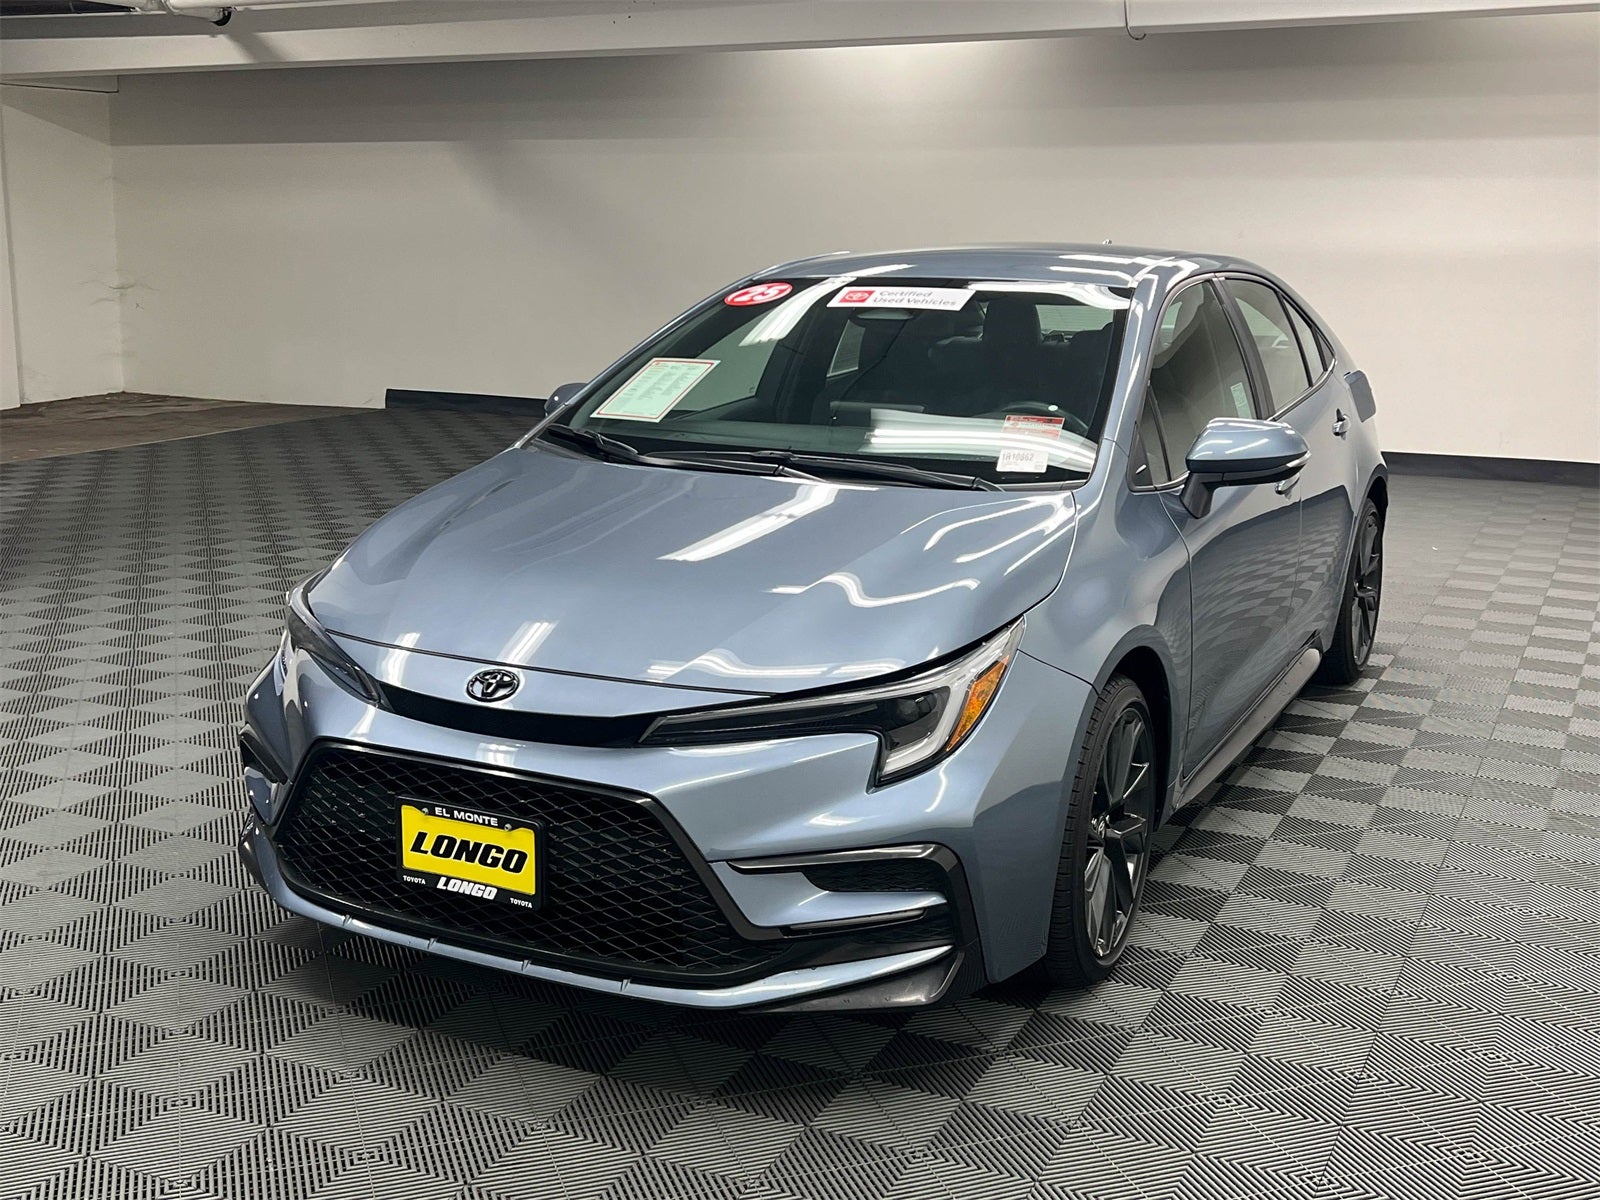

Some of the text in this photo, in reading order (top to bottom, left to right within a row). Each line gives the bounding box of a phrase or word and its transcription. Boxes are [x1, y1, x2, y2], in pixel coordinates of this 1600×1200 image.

[733, 284, 790, 303] 25
[879, 290, 934, 298] Certified
[435, 807, 498, 826] EL MONTE
[410, 831, 528, 873] LONGO
[403, 875, 426, 885] TOYOTA
[437, 877, 497, 900] LONGO
[510, 897, 532, 908] TOYOTA
